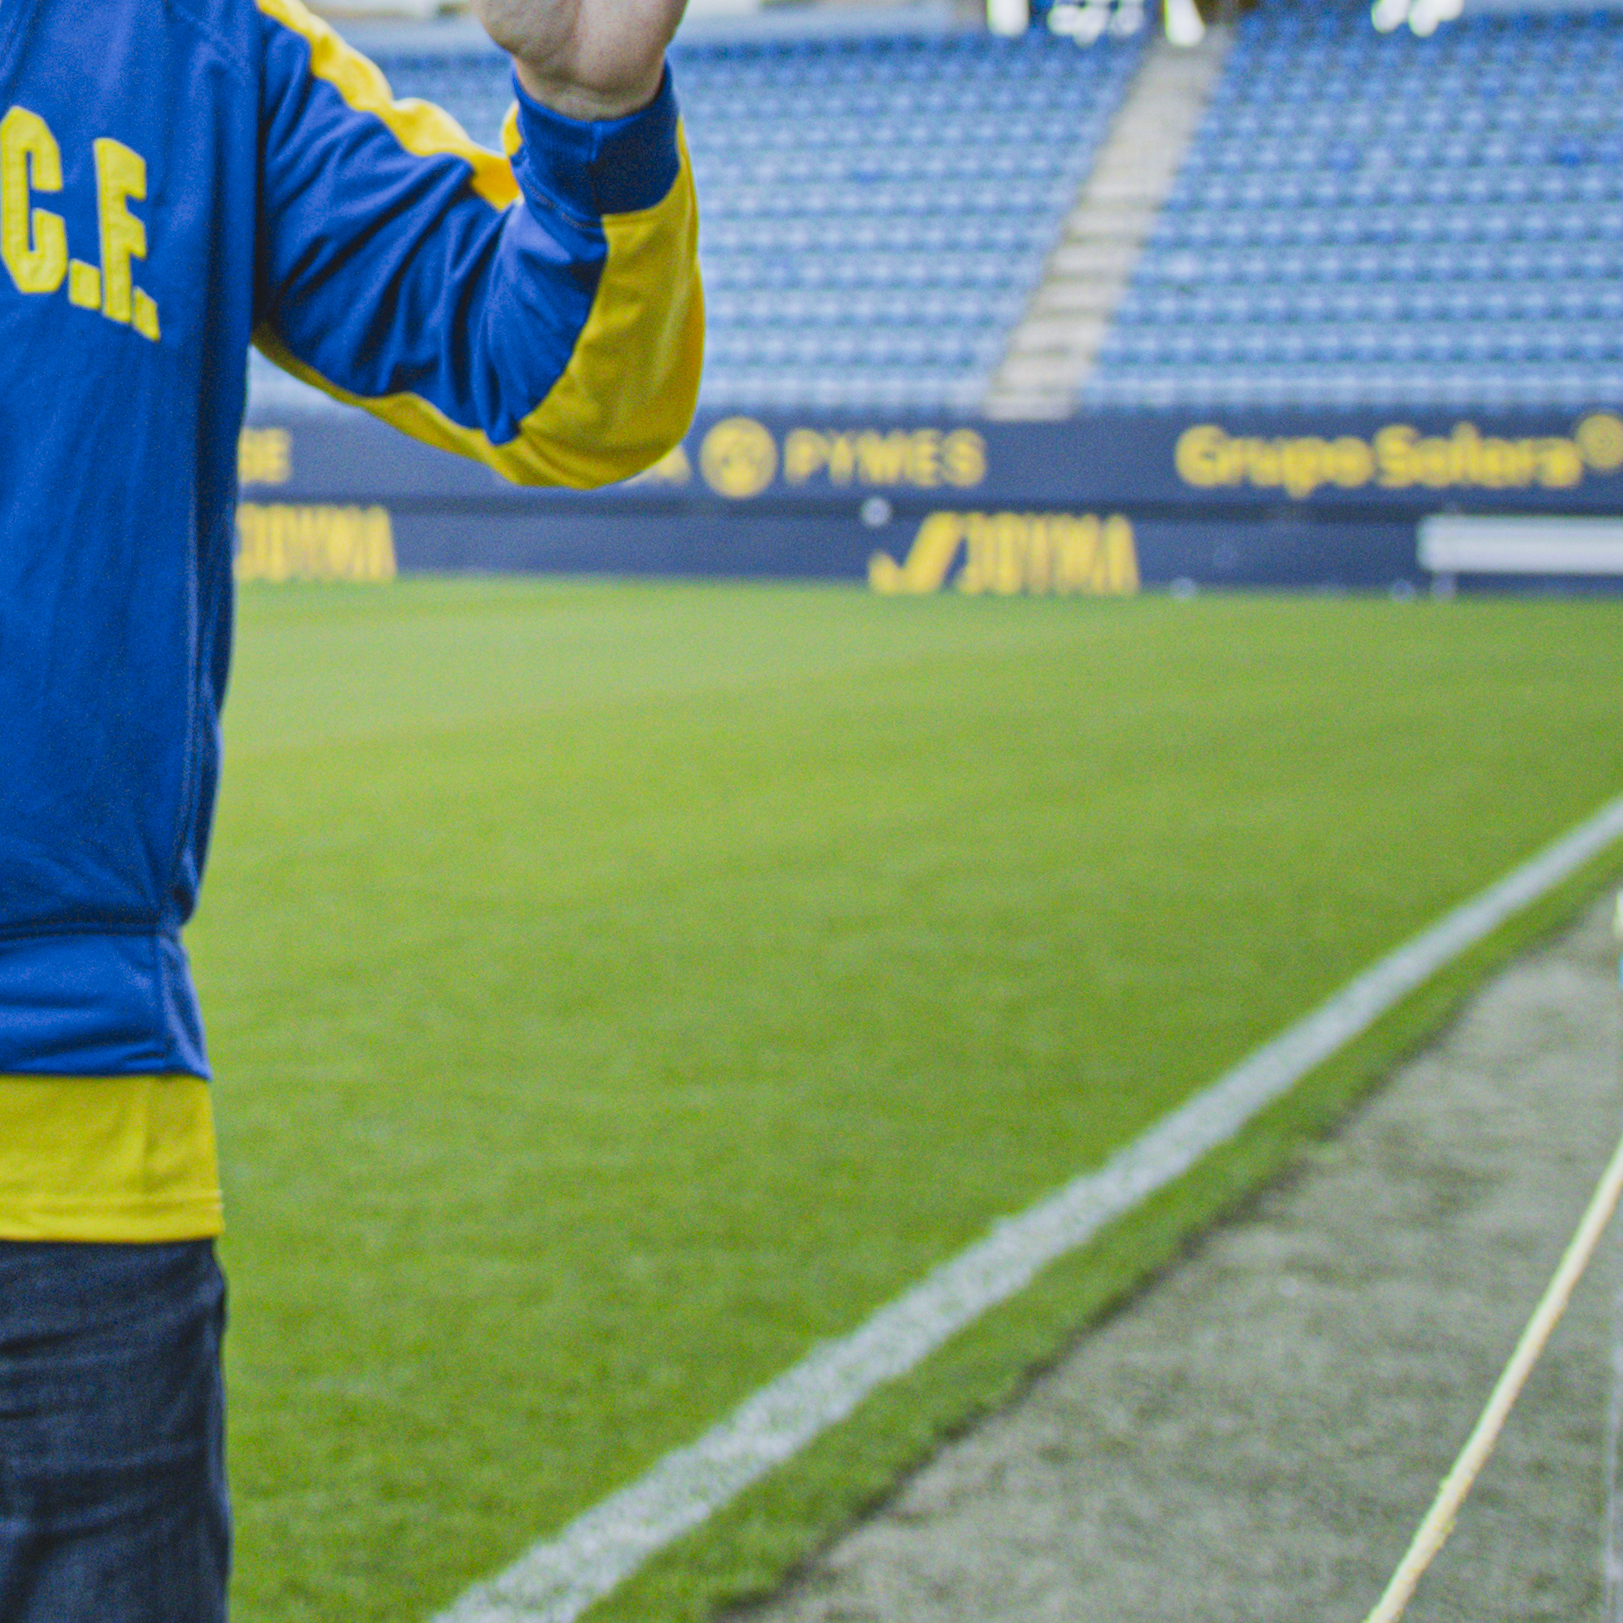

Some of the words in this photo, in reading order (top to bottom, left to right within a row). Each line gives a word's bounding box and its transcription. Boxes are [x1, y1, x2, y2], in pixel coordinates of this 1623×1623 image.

[783, 427, 986, 488] PYMES
[1174, 423, 1374, 499] Grupo
[1374, 421, 1584, 489] Solera
